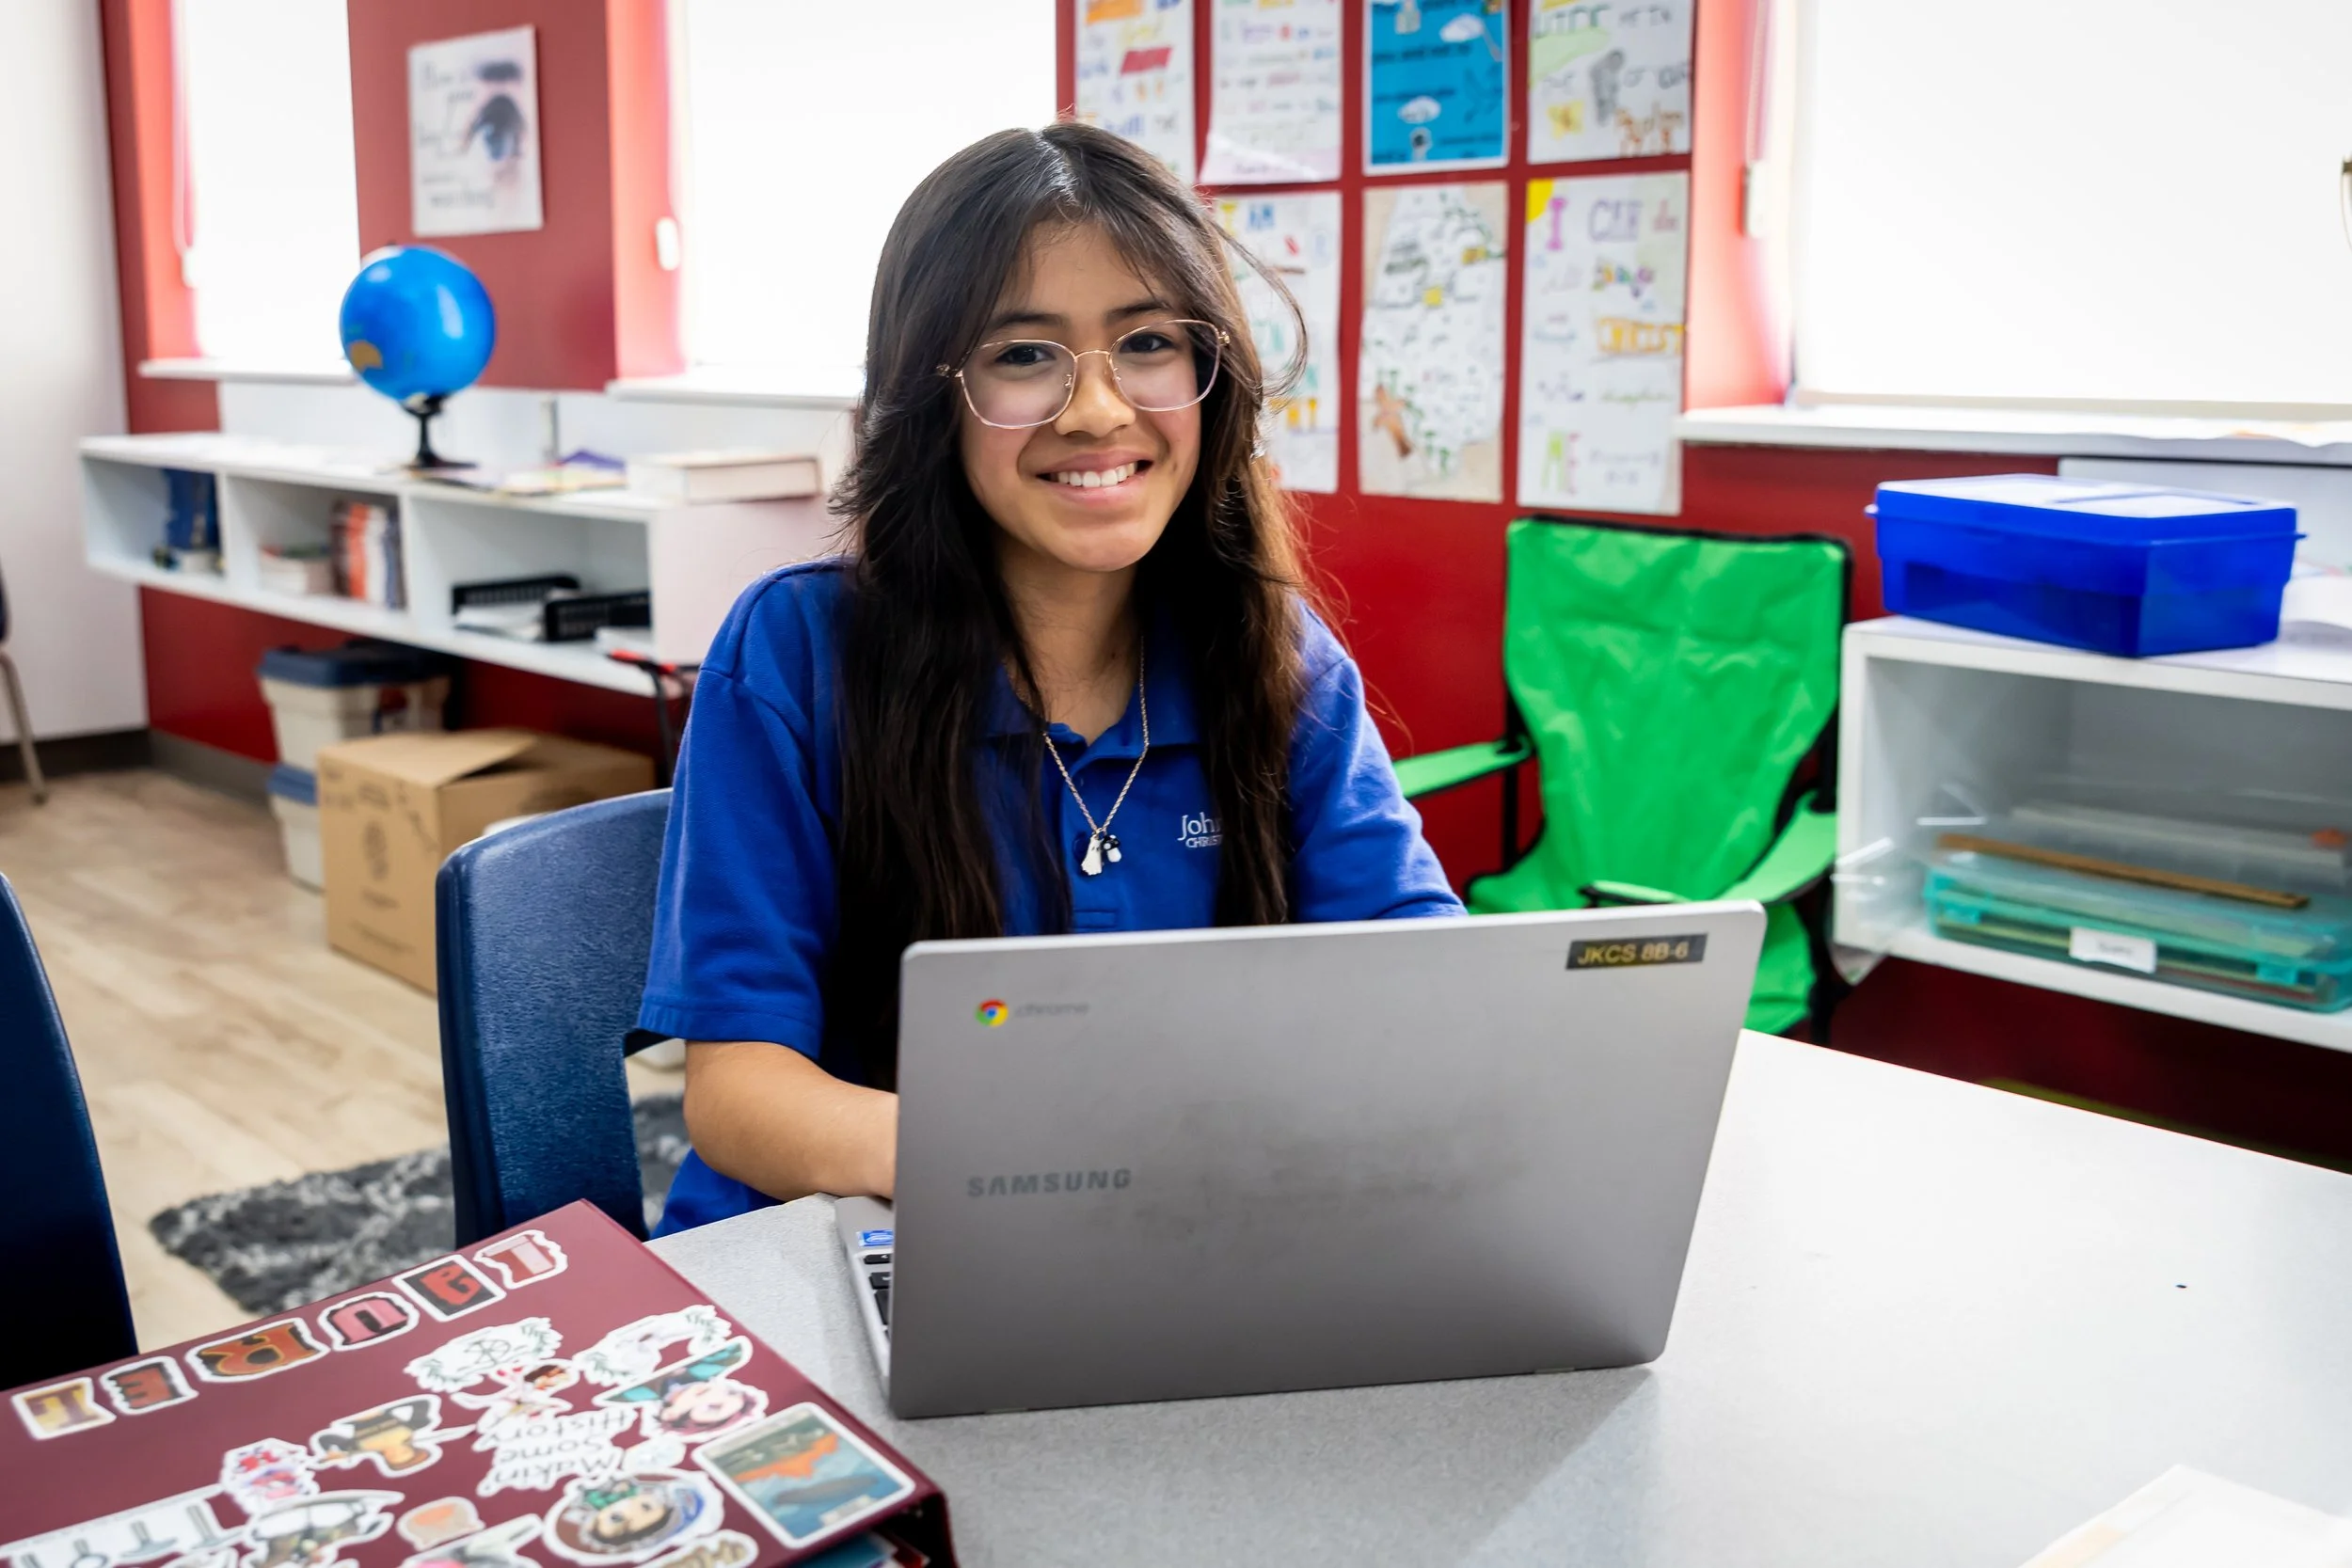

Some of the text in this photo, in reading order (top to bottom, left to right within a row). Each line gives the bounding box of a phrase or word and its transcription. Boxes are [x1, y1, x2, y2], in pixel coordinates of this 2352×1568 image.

[1578, 942, 1689, 965] JKCS 8B-6
[967, 1168, 1132, 1197] SAMSUNG
[481, 1410, 628, 1442] History
[500, 1437, 603, 1463] Some
